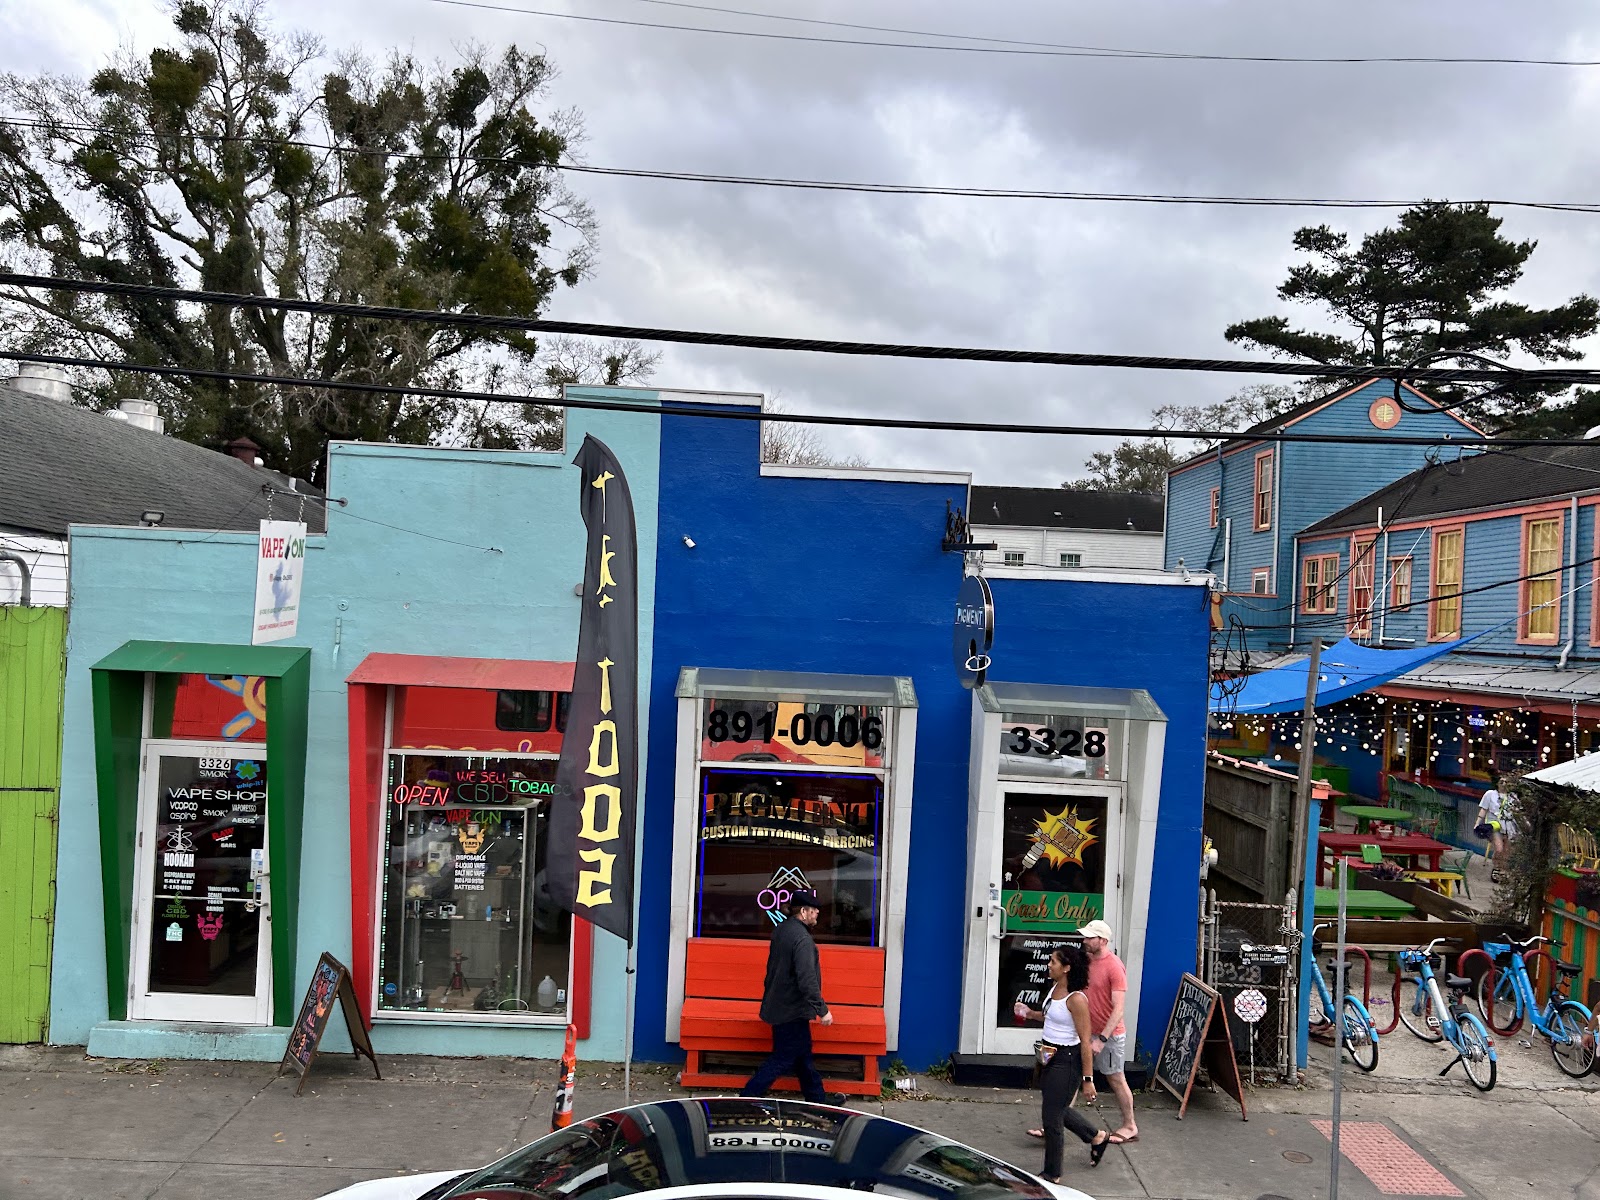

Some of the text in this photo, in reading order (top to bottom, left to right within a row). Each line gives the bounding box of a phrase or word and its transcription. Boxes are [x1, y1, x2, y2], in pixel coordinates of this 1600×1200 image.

[261, 537, 304, 558] VAPE ON
[957, 608, 983, 626] PIGMENT
[708, 710, 882, 749] 891-0006
[1010, 726, 1106, 758] 3328
[200, 758, 230, 768] 3326
[200, 770, 228, 778] SMOK
[456, 772, 506, 784] WE SELL
[236, 780, 264, 790] whip-it!
[168, 788, 266, 802] VAPE SHOP
[394, 784, 450, 806] OPEN
[458, 784, 508, 802] CBD
[170, 801, 198, 811] VOOPOO
[232, 804, 256, 812] VAPORESSO
[702, 792, 876, 826] PIGMENT
[170, 812, 197, 822] aspire
[202, 809, 227, 818] SMOK
[446, 809, 472, 823] VAPE
[212, 827, 234, 840] RAW
[702, 825, 748, 840] CUSTOM
[751, 826, 810, 842] TATTOOING
[822, 834, 874, 849] PIERCING
[164, 852, 194, 868] HOOKAH
[757, 889, 816, 910] OP
[1006, 892, 1098, 928] Cash Only
[1016, 990, 1040, 1004] ATM
